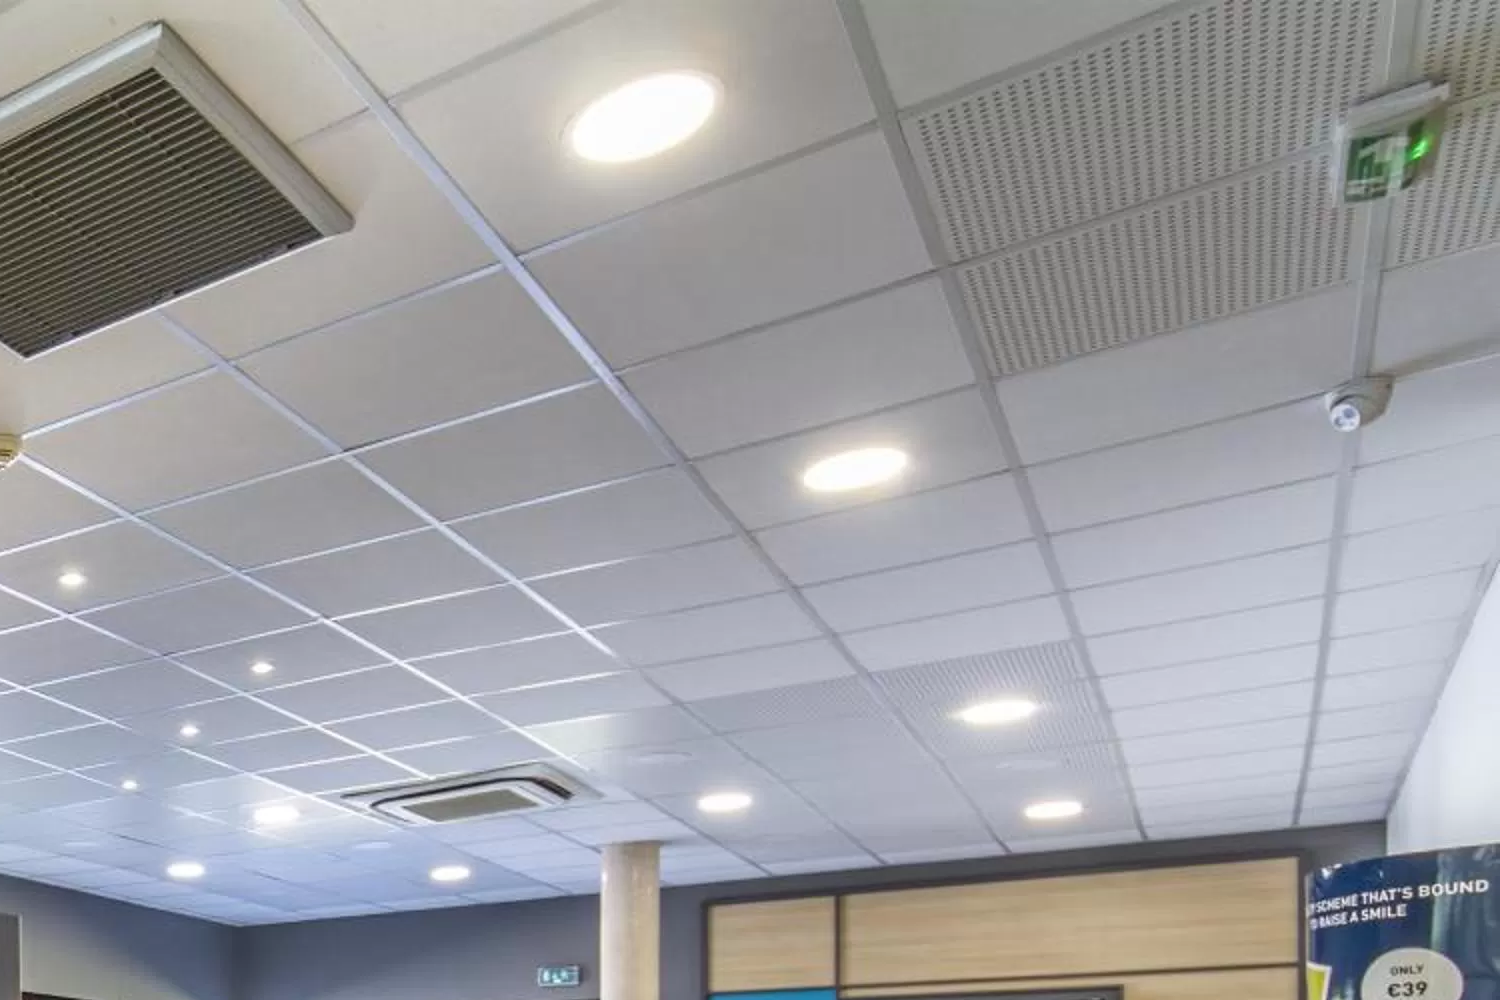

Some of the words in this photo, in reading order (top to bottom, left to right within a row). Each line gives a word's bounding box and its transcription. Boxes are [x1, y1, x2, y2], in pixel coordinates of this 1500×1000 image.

[1316, 893, 1358, 913] SCHEME
[1361, 886, 1414, 905] THAT'S
[1418, 879, 1490, 898] BOUND
[1350, 911, 1359, 923] A
[1361, 904, 1407, 922] SMILE
[1389, 963, 1425, 977] ONLY
